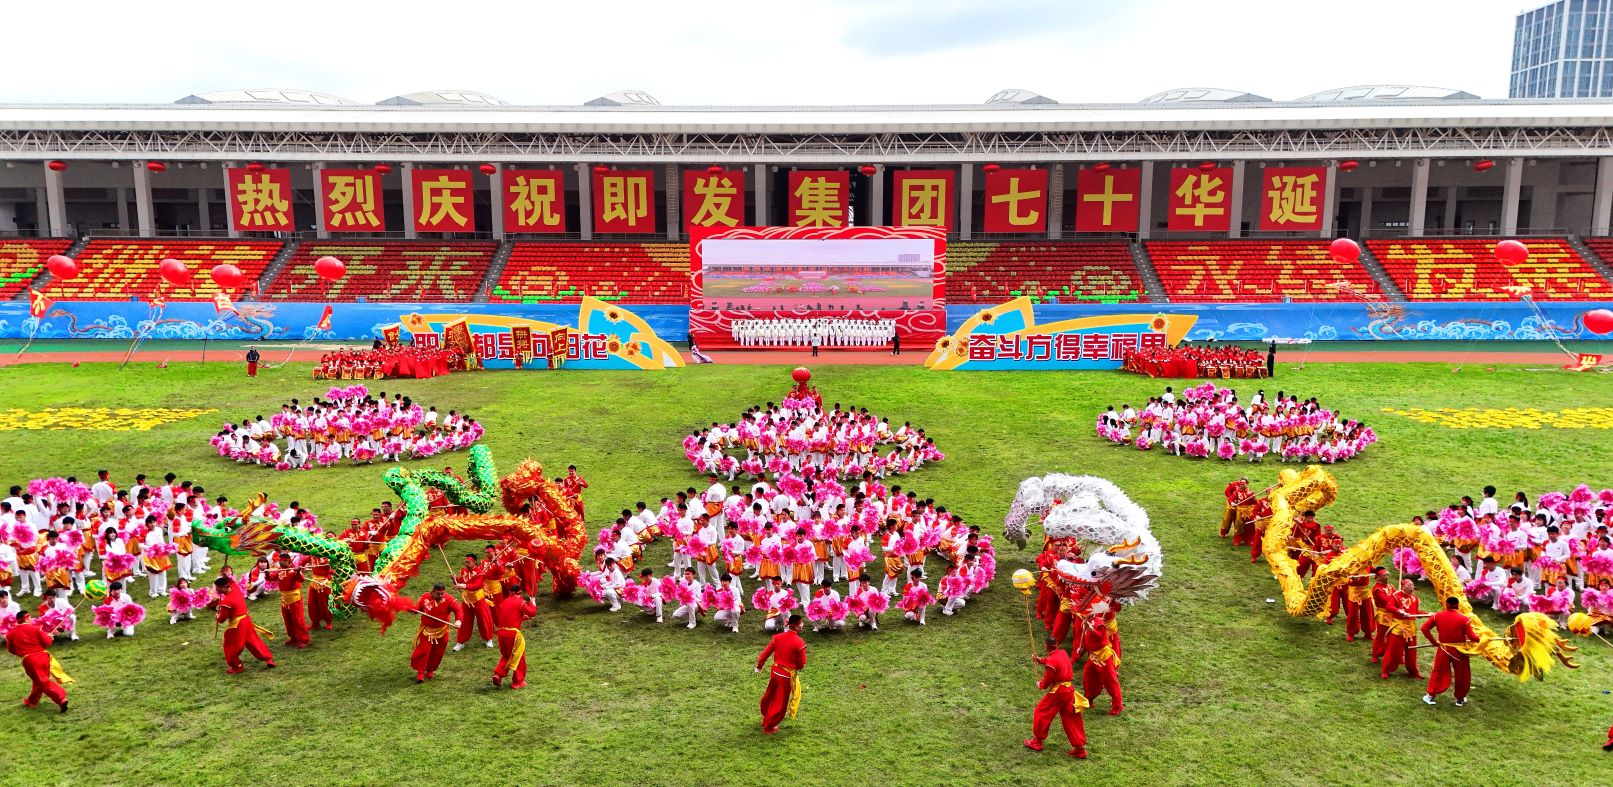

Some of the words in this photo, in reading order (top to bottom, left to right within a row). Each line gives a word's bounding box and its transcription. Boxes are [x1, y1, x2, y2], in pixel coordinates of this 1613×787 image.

[236, 172, 1319, 228] 热烈庆祝即发集团七十华诞
[412, 332, 610, 361] 职都是向花
[554, 332, 567, 353] 向上
